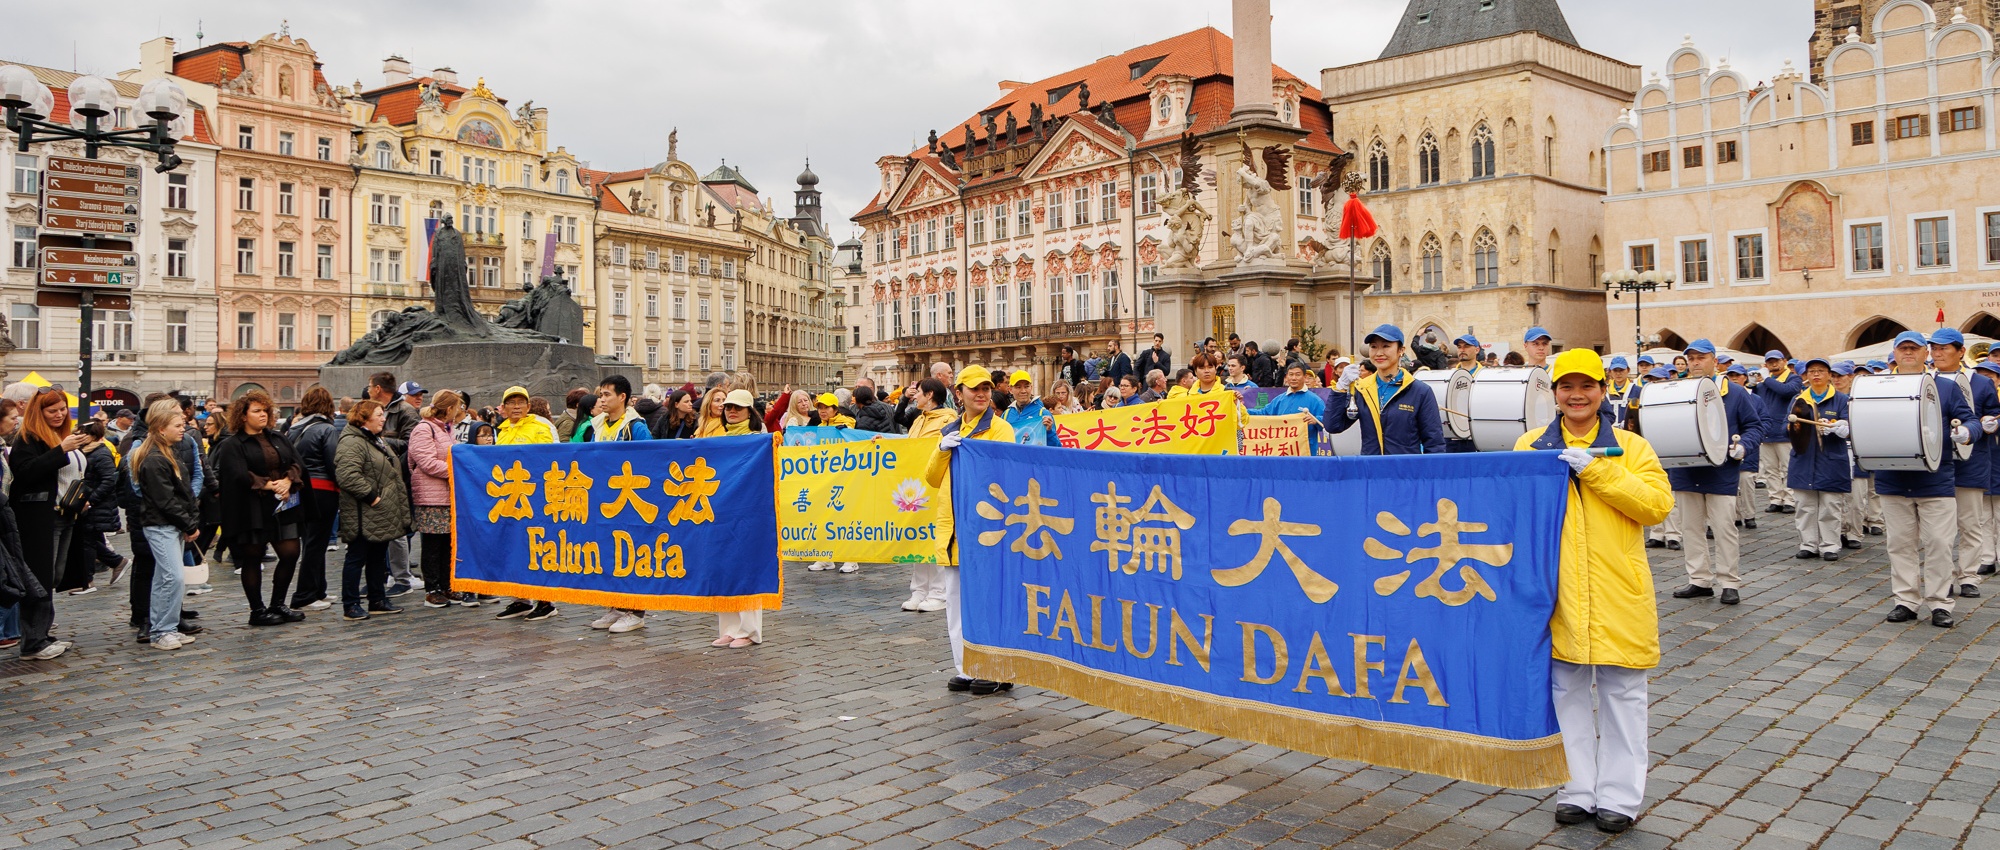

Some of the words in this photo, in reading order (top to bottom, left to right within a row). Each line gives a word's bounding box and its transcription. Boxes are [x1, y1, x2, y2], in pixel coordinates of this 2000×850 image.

[94, 183, 124, 195] Rudolfinum
[80, 200, 102, 211] Staronová
[103, 204, 123, 215] synagoga
[76, 219, 88, 230] Starý
[93, 273, 107, 283] Metro
[110, 274, 119, 282] A
[780, 444, 897, 481] potřebuje
[486, 456, 721, 526] 法輪大法
[825, 521, 937, 541] Snášenlivost
[976, 477, 1513, 606] 法輪大法
[526, 526, 604, 574] Falun
[612, 529, 687, 578] Dafa
[781, 548, 834, 560] w.falundafa.org
[1022, 582, 1214, 673] FALUN
[1236, 620, 1451, 708] DAFA
